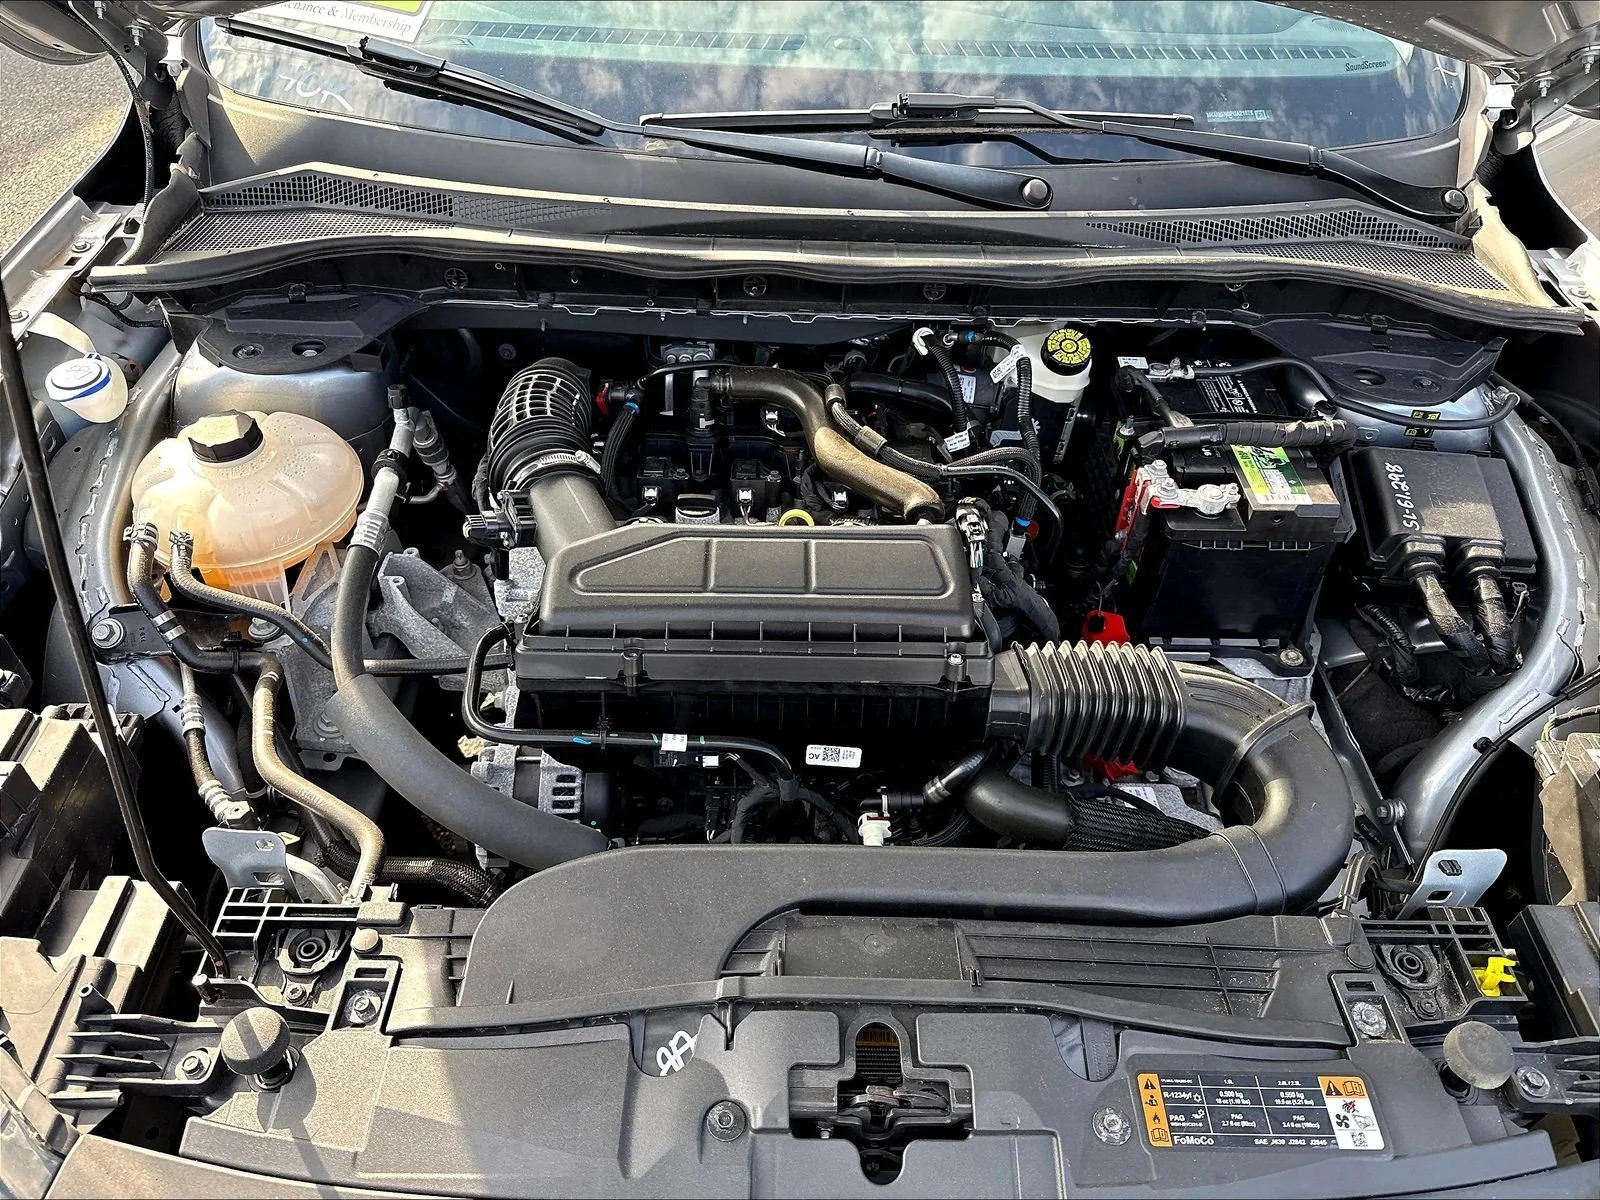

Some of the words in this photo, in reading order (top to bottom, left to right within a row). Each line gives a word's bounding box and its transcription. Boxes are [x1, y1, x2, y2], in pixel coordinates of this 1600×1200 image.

[327, 4, 339, 17] &
[340, 7, 412, 36] Membership
[808, 752, 821, 760] AC
[1163, 1091, 1192, 1100] R-1234yf
[1169, 1114, 1186, 1122] PAG
[1173, 1135, 1215, 1145] FoMoCo
